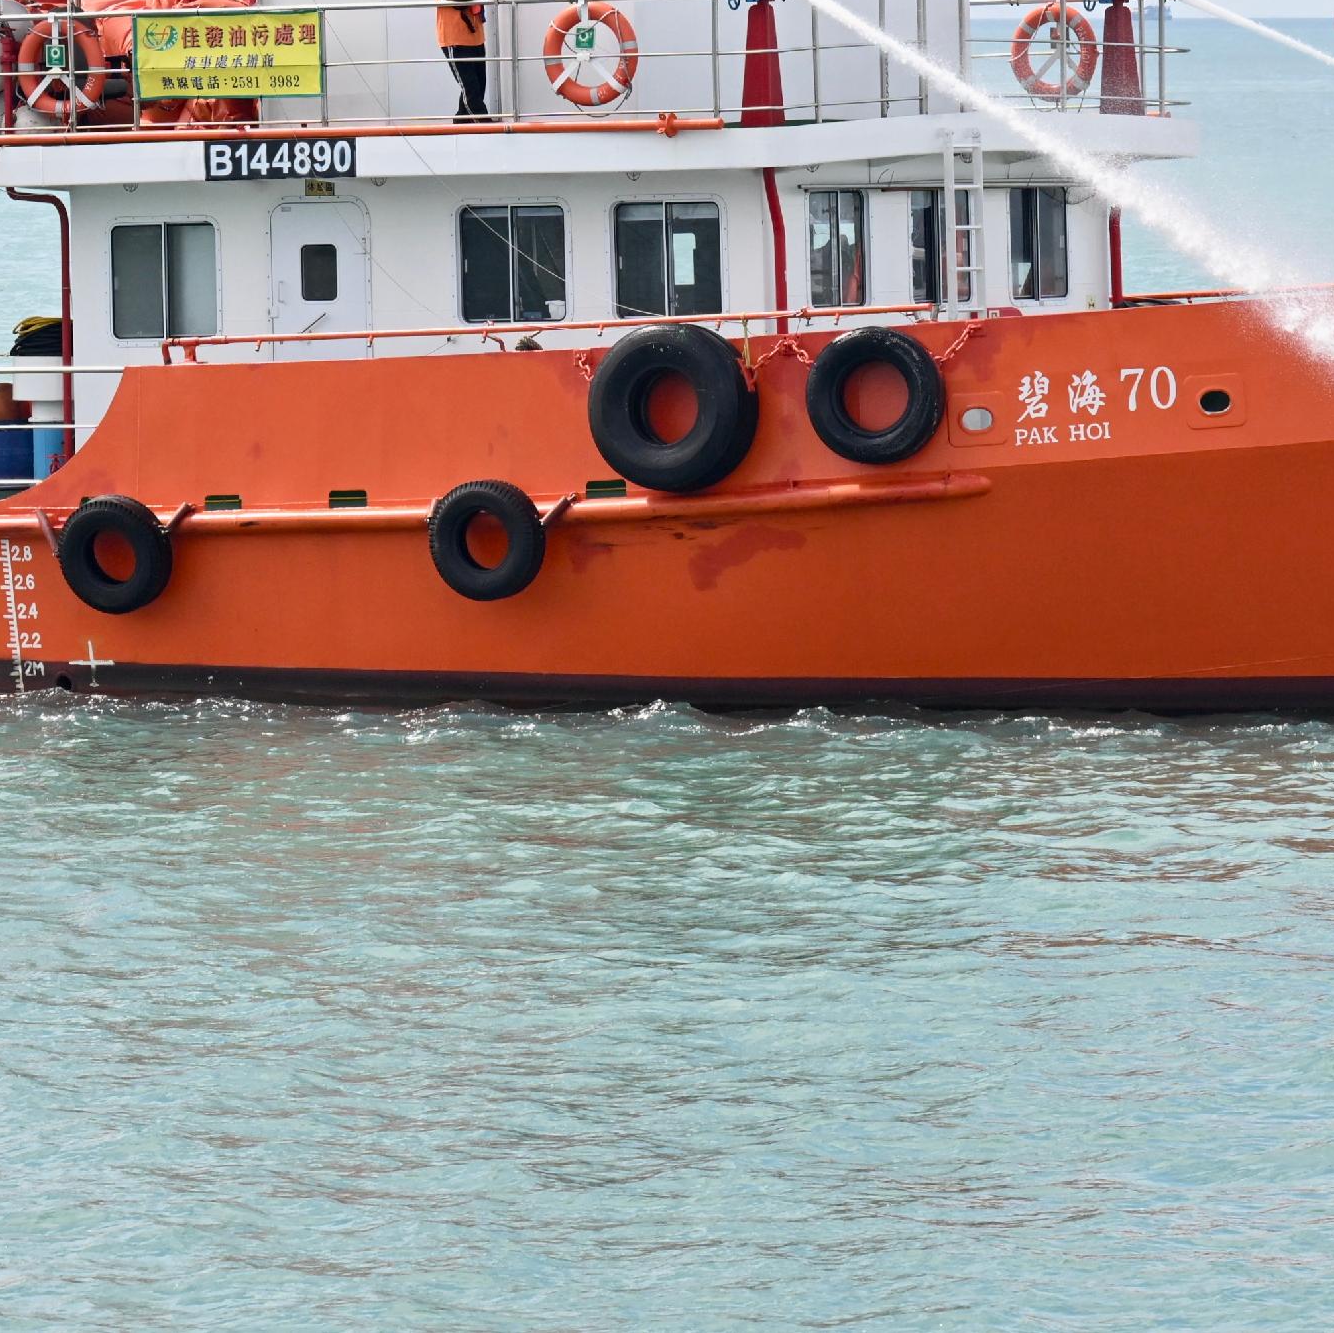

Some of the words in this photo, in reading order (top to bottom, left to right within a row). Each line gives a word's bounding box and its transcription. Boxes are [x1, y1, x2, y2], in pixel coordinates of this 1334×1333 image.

[181, 23, 317, 49] 佳發油污處理
[269, 74, 300, 88] 3982
[210, 140, 352, 177] B144890
[1017, 370, 1106, 423] 碧海
[1120, 366, 1177, 412] 70
[1015, 426, 1058, 447] PAK
[1068, 421, 1111, 442] HOI
[11, 545, 33, 562] 2.8
[14, 574, 35, 590] 2.6
[17, 602, 38, 620] 2.4
[20, 632, 43, 649] 2.2
[24, 661, 45, 677] 2M
